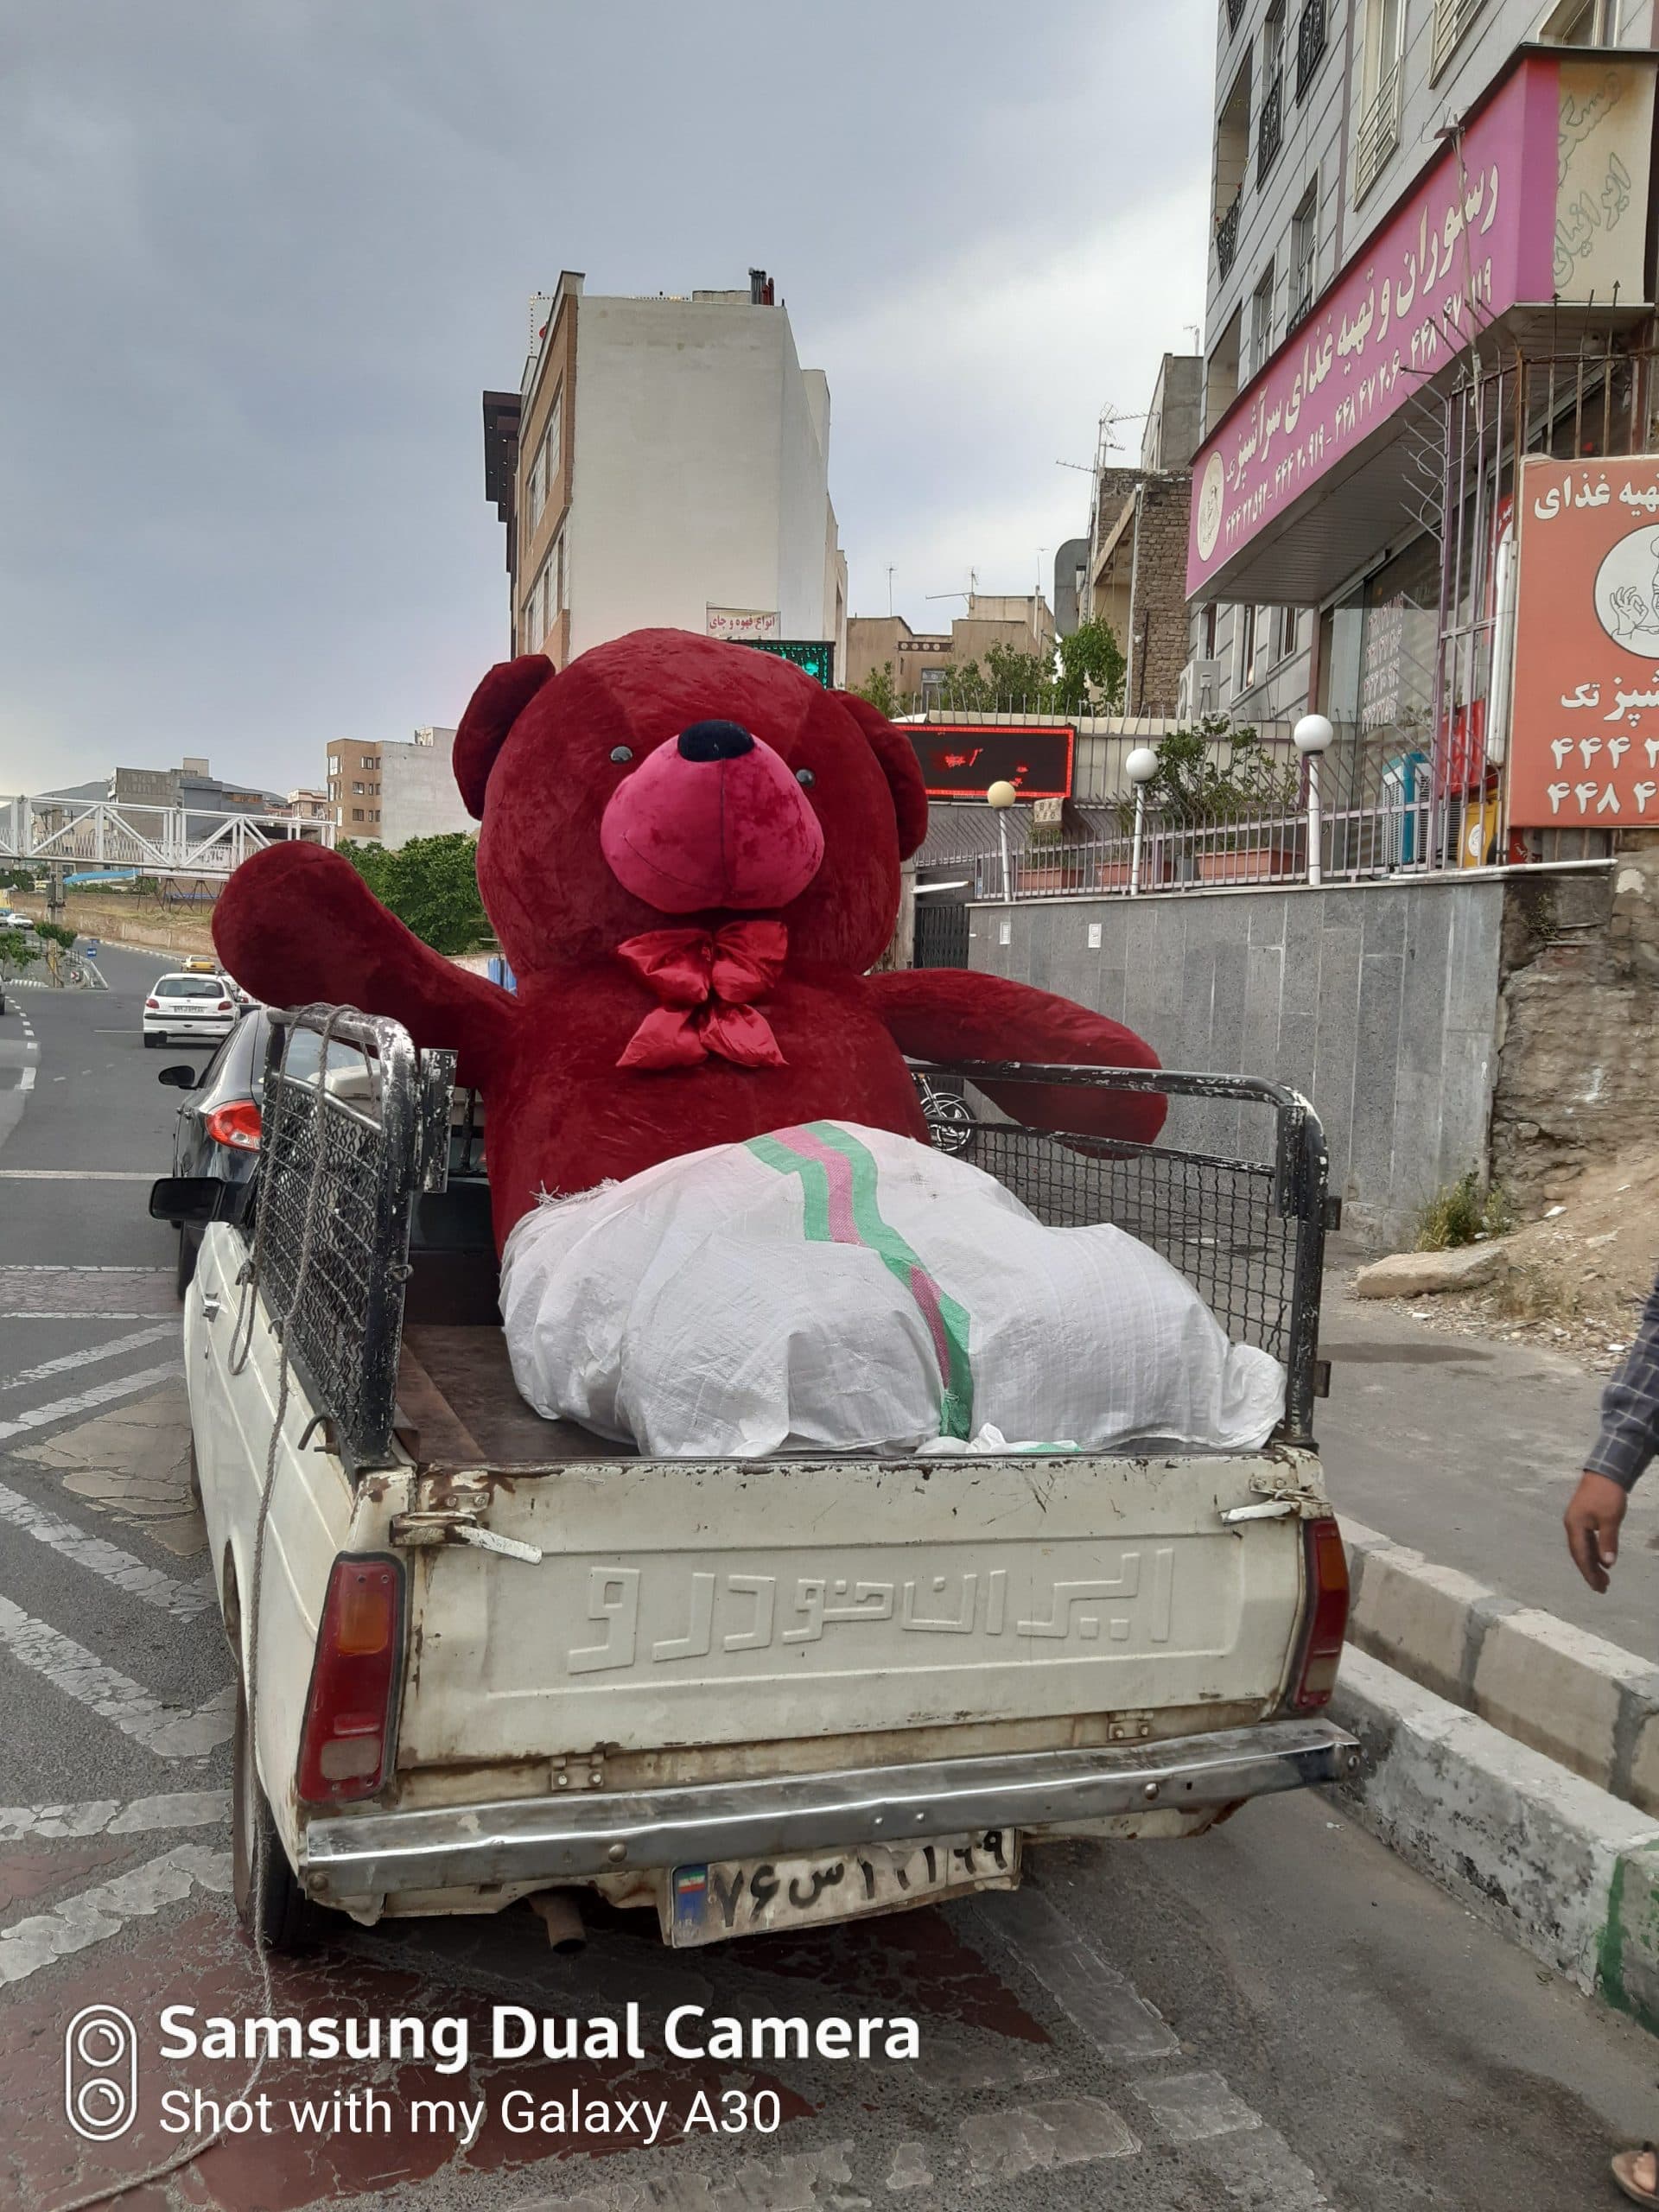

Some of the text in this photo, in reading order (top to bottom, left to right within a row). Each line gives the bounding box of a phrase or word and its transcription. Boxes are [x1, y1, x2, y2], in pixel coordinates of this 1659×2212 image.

[1396, 163, 1499, 318] رستوران
[1337, 266, 1375, 376] تهیه
[1376, 277, 1390, 343] و
[1284, 312, 1333, 435] غذای
[1233, 385, 1282, 492] سرآشپز
[1534, 473, 1611, 520] غذای
[729, 620, 734, 630] و
[735, 614, 753, 630] قهوه
[755, 616, 775, 630] انواع
[1560, 683, 1601, 709] تک
[1550, 736, 1631, 770] ۴۴۴
[1548, 782, 1621, 814] ۴۴۸
[567, 1548, 1174, 1675] ایران خودرو
